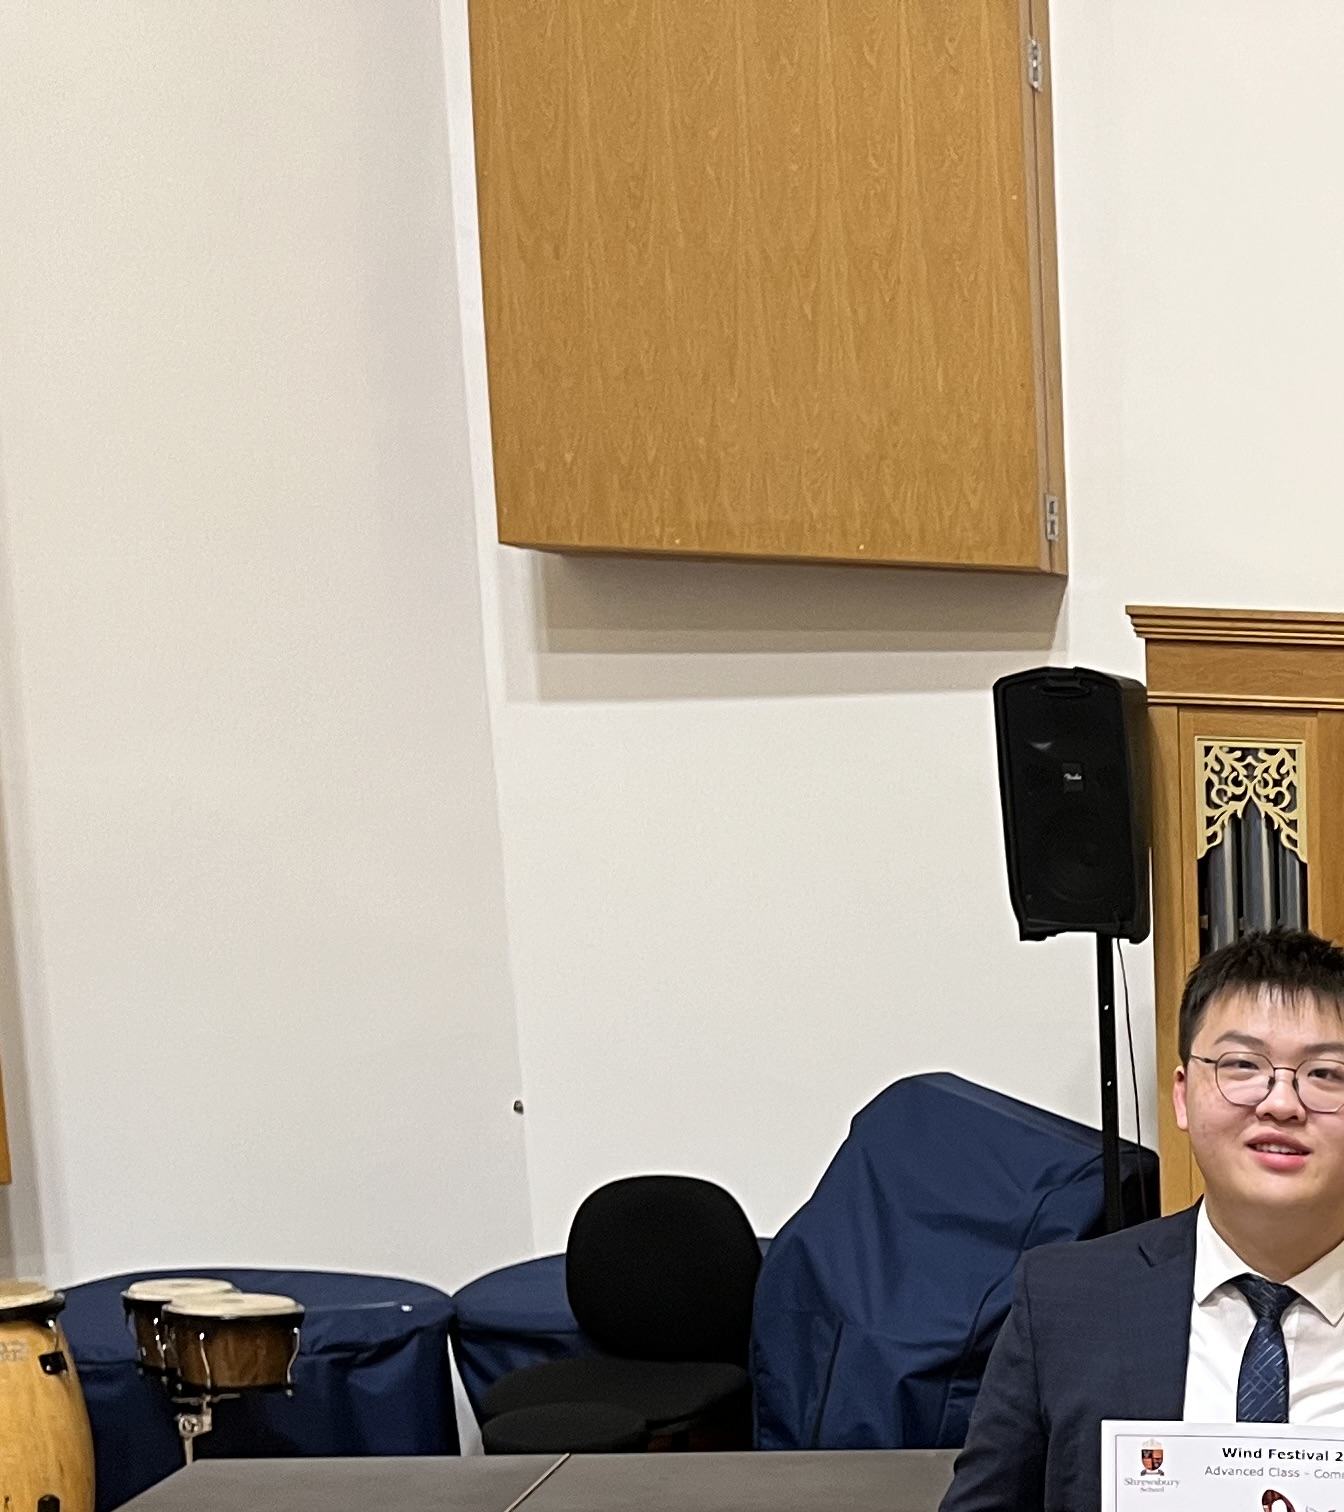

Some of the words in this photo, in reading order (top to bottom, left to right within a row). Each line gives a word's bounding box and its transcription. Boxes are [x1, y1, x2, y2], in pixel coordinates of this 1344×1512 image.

[1221, 1447, 1262, 1459] Wind
[1268, 1449, 1329, 1462] Festival
[1204, 1466, 1264, 1477] Advanced
[1268, 1467, 1301, 1478] Class
[1124, 1477, 1180, 1488] Shrewsbury
